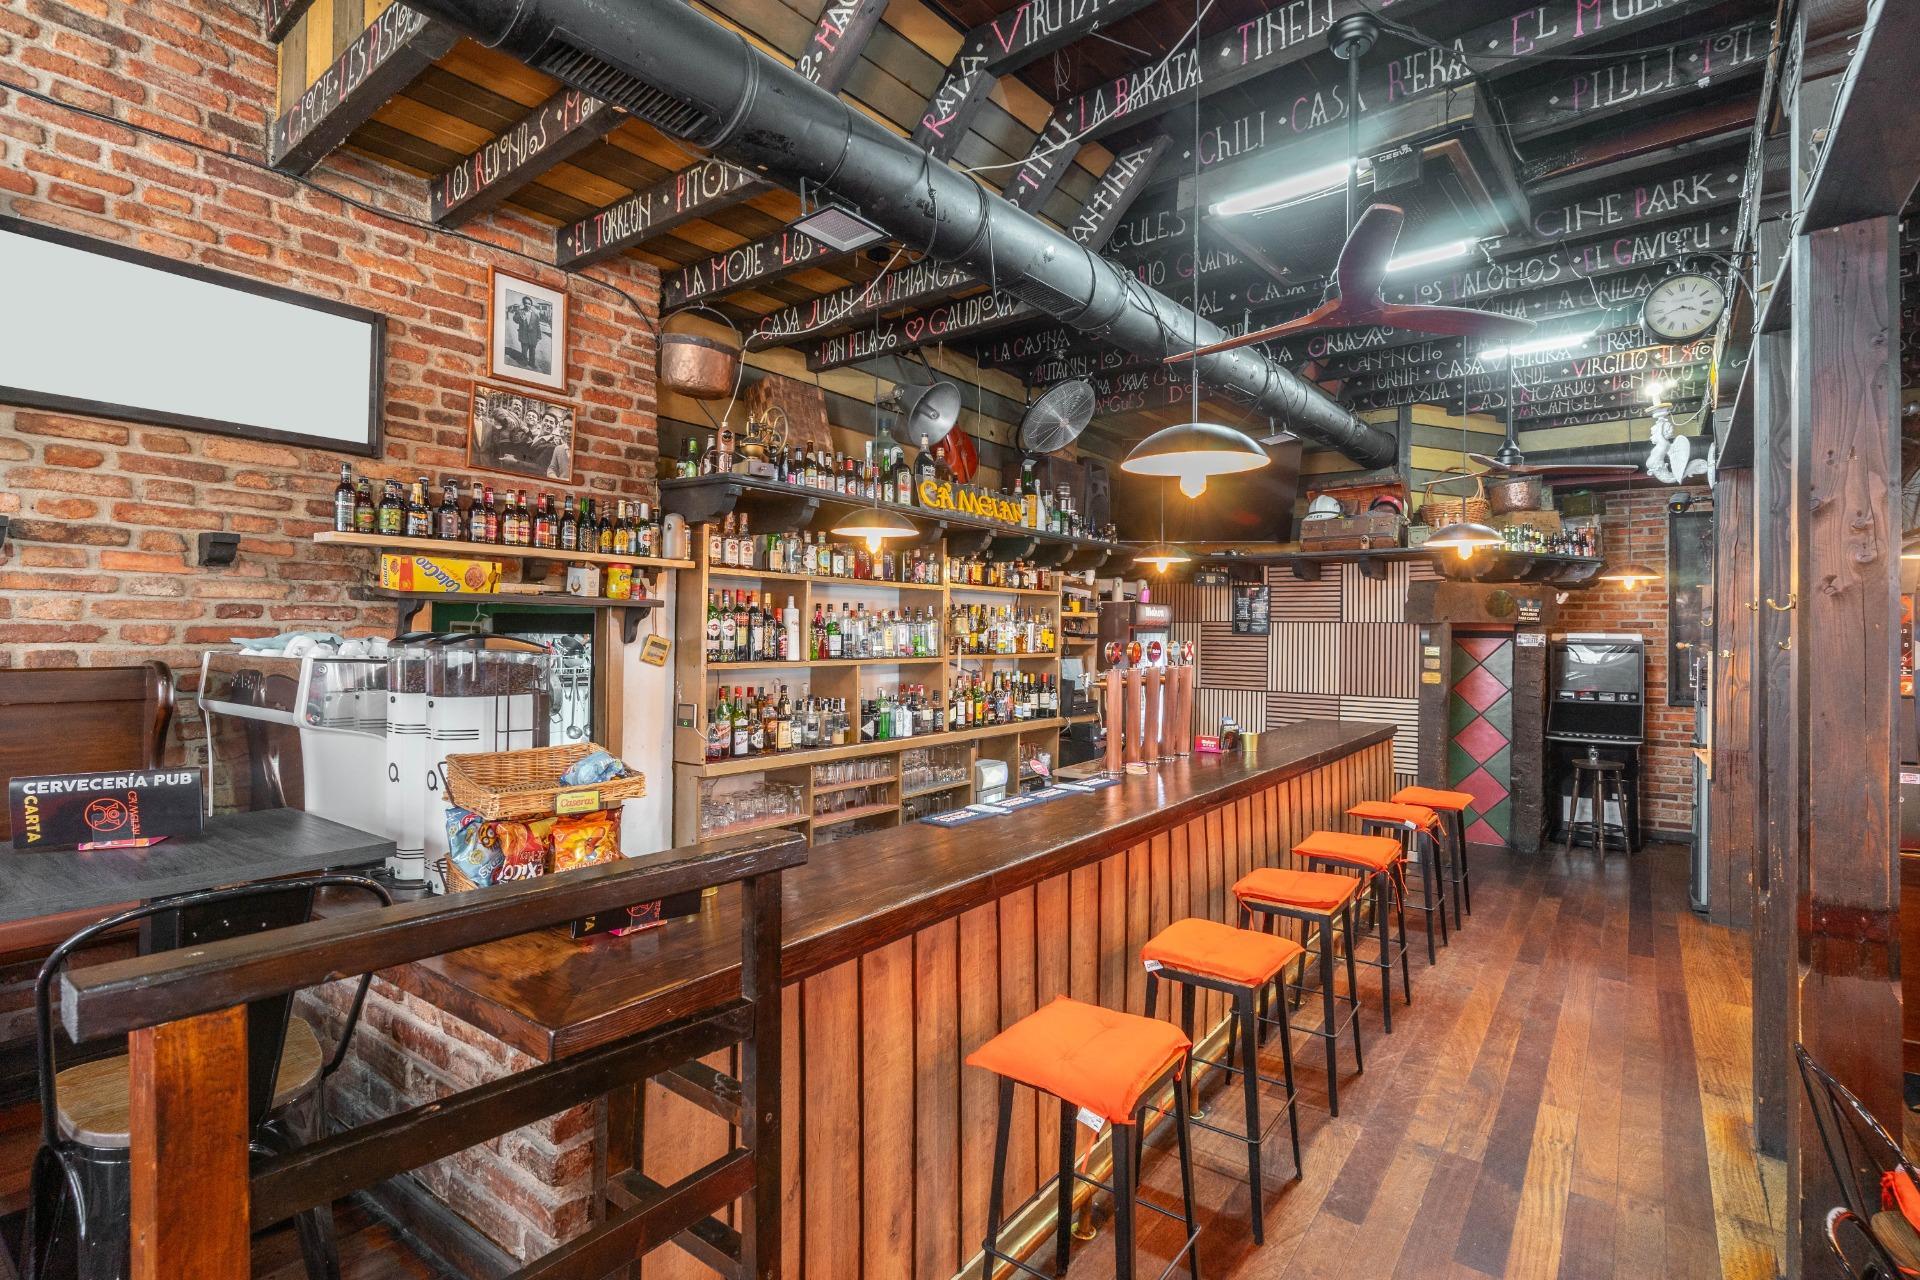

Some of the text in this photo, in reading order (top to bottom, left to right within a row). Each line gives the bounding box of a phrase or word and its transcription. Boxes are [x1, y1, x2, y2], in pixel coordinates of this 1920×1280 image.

[1511, 8, 1557, 58] EL
[1079, 48, 1203, 132] LA BARATA
[1290, 85, 1369, 133] CASA
[445, 160, 469, 208] LOS
[475, 108, 549, 191] REDONDOS
[575, 223, 591, 256] EL
[594, 193, 651, 248] TORREON
[1535, 174, 1716, 236] CINE PARK
[1111, 211, 1186, 253] CULES
[684, 266, 706, 298] LA
[711, 243, 764, 290] MODE
[1583, 248, 1610, 273] EL
[760, 307, 800, 340] CASA
[806, 289, 854, 328] JUAN
[821, 336, 845, 365] DON
[850, 323, 897, 357] PELAYO
[1572, 350, 1648, 378] VIRGILIO
[1436, 359, 1486, 381] CASA
[23, 773, 192, 795] CERVECERÍA PUB
[23, 795, 42, 844] CARTA
